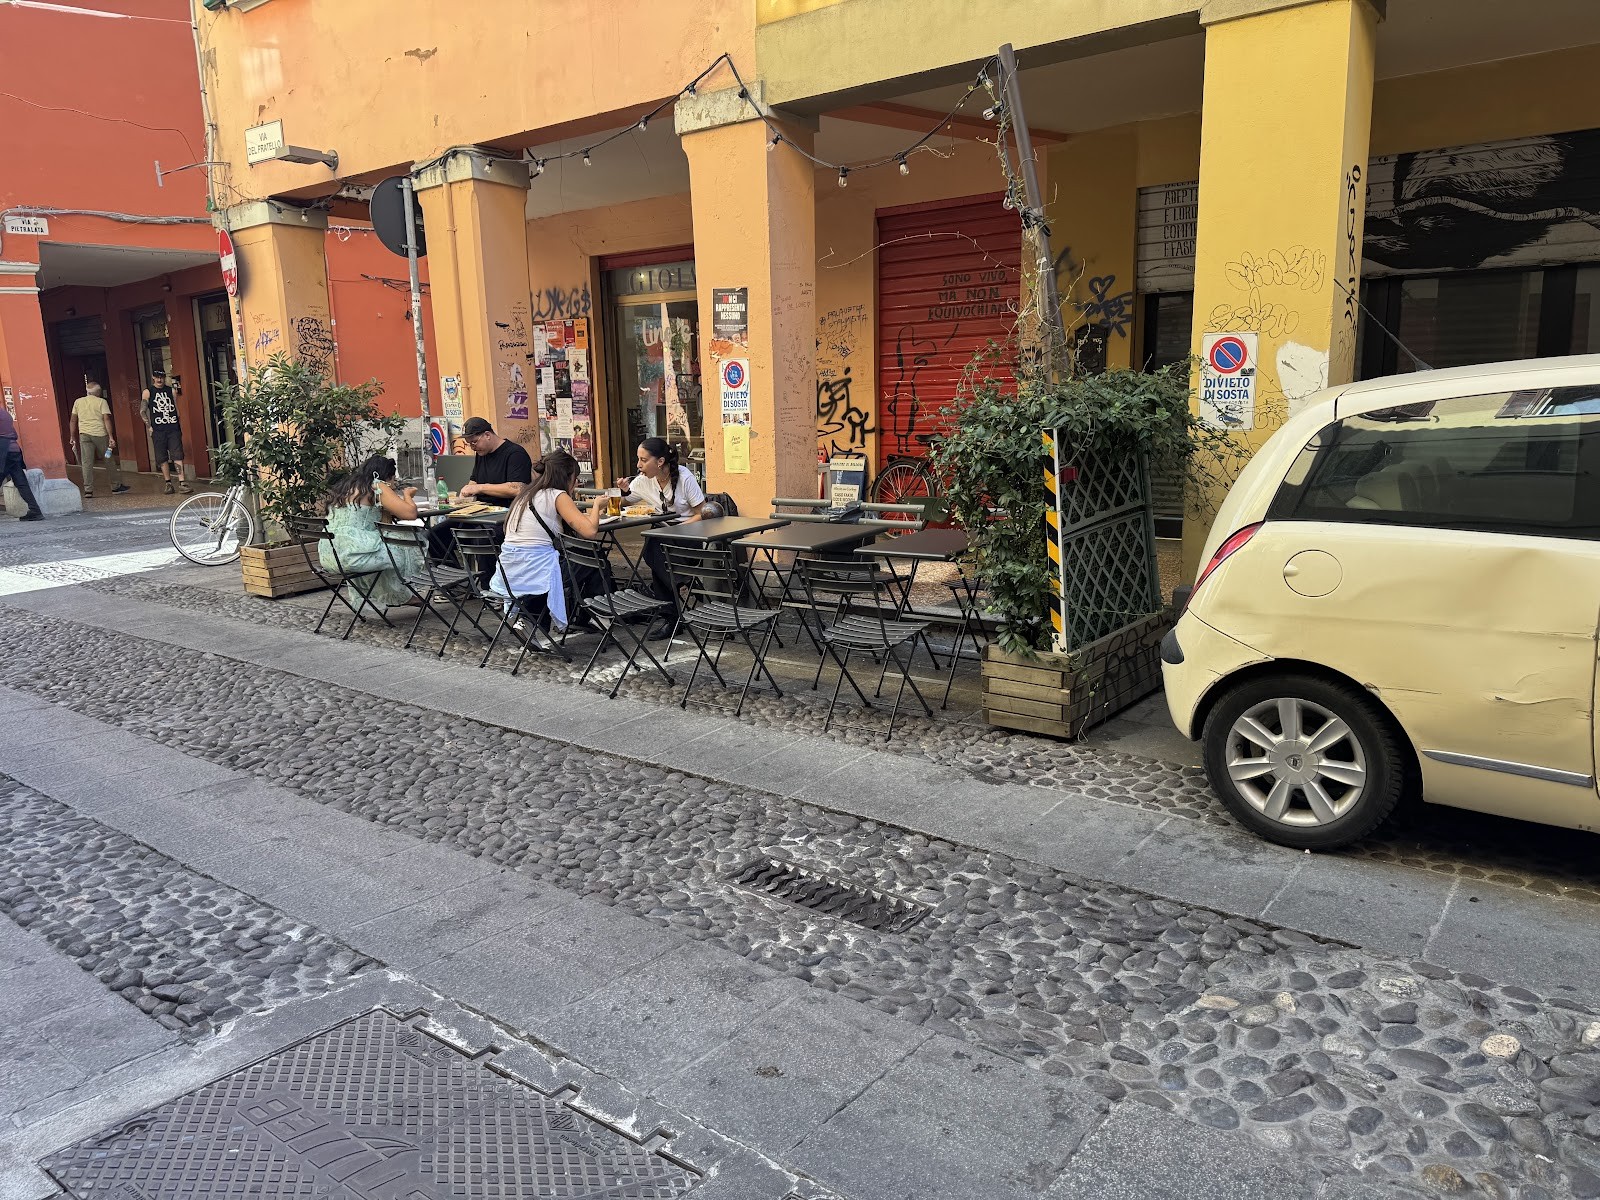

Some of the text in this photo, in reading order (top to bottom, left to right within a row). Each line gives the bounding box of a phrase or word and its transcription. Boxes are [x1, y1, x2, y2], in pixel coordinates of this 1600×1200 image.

[258, 132, 268, 142] VIA
[248, 146, 258, 156] DEL
[11, 225, 44, 233] PIETRALATA
[942, 273, 971, 286] SONO
[938, 286, 1000, 301] MA NON
[1205, 377, 1250, 388] DIVIETO
[723, 391, 748, 399] DIVIETO
[1204, 389, 1249, 400] DI SOSTA
[723, 400, 748, 408] DI SOSTA
